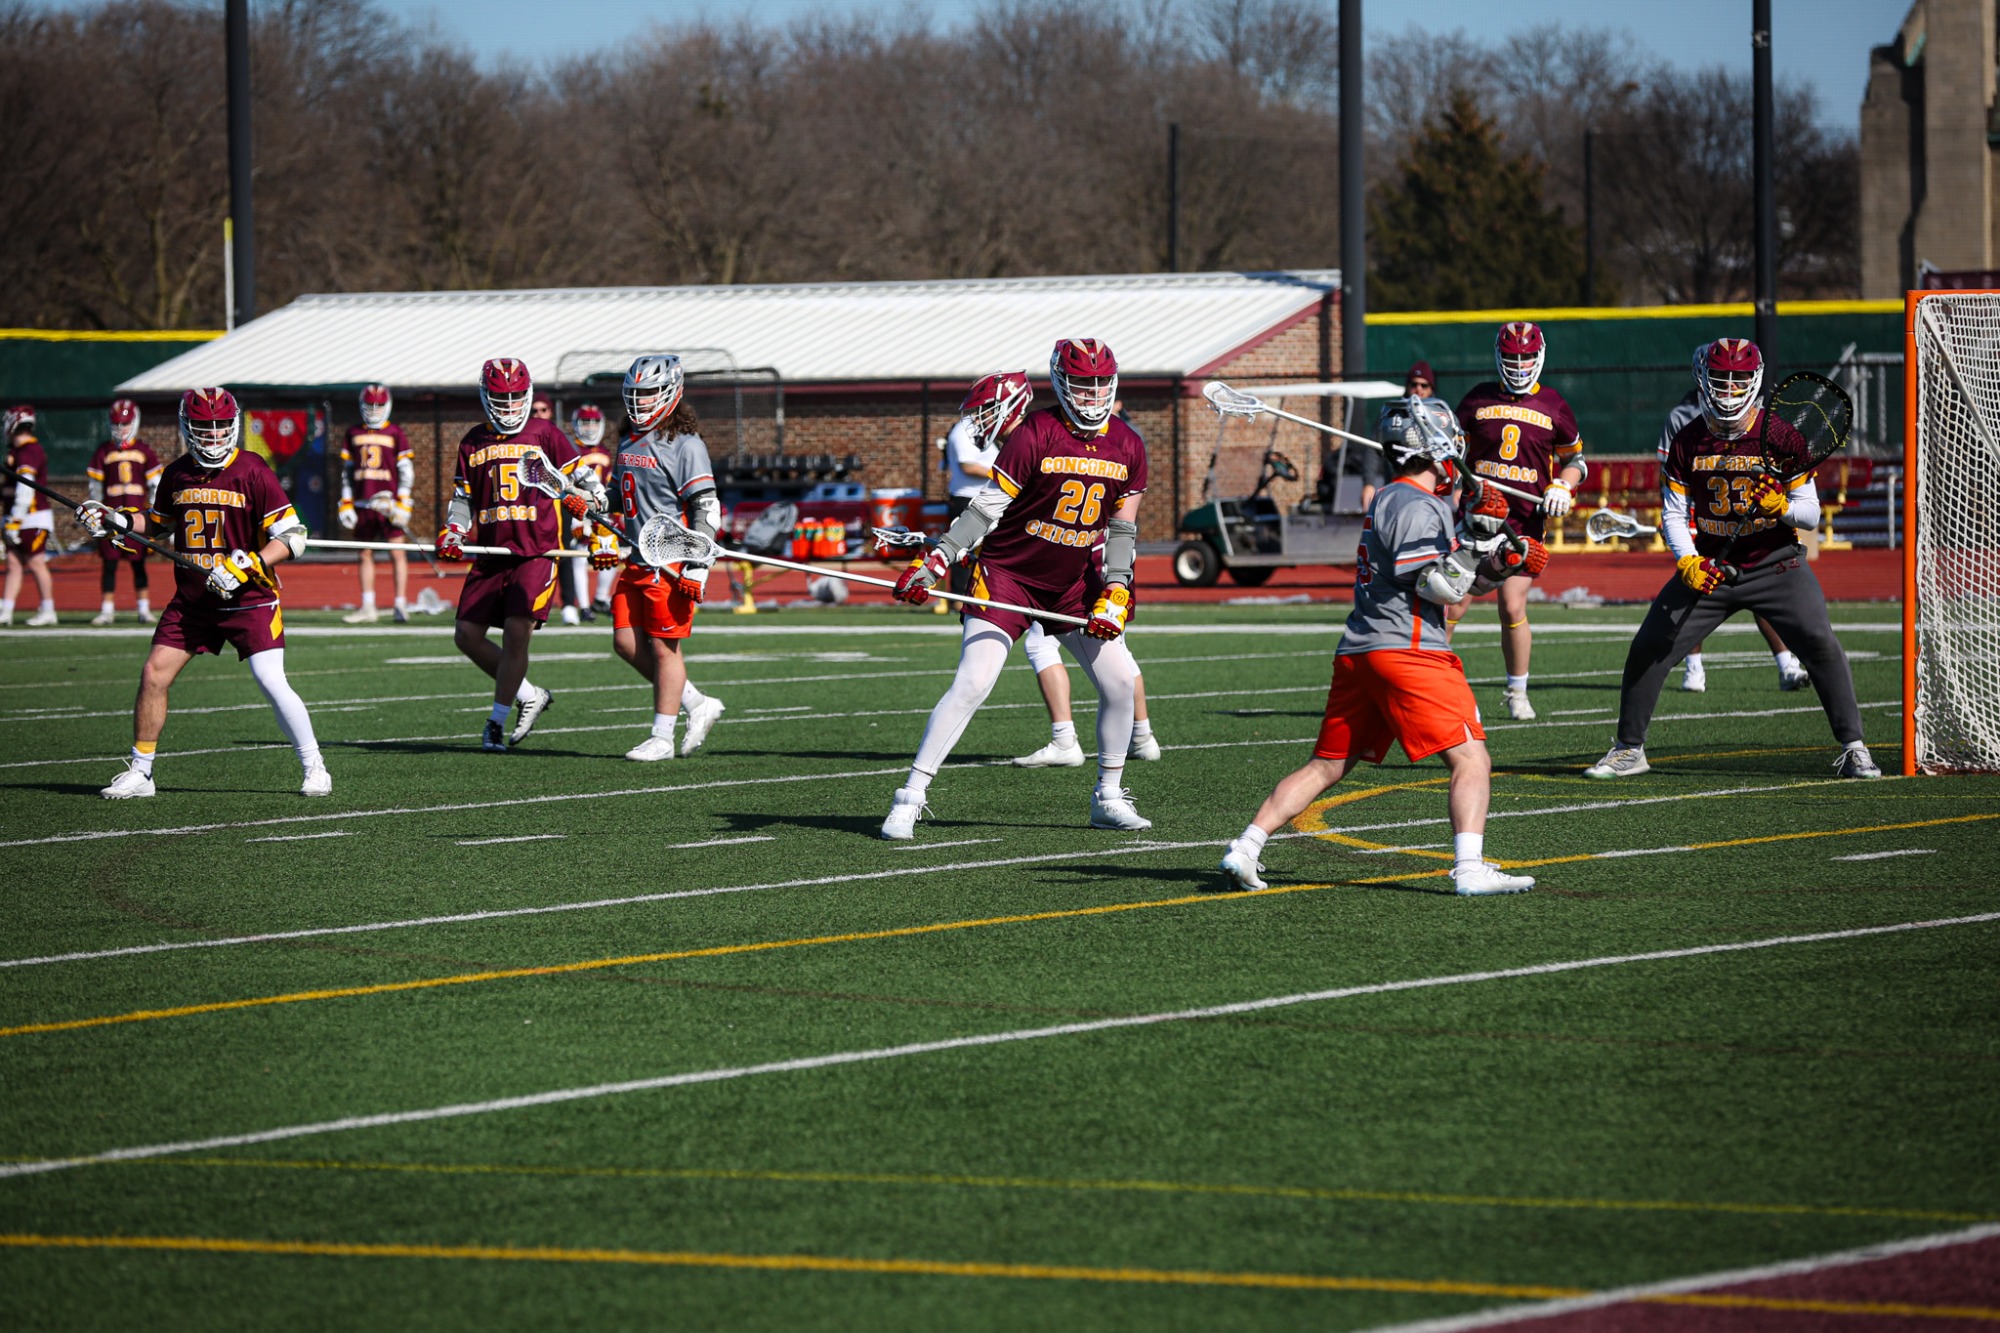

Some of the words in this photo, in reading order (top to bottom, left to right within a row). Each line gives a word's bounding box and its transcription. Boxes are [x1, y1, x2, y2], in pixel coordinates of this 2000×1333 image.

[1475, 404, 1553, 431] CONCORDIA
[1498, 423, 1521, 461] 8
[617, 452, 658, 469] DERSON
[1041, 456, 1129, 481] CONCORDIA
[1474, 459, 1539, 484] CHICAGO
[1692, 454, 1778, 473] ONCORD
[488, 463, 520, 502] 15
[621, 470, 639, 519] 8
[1706, 476, 1755, 516] 33
[172, 487, 246, 509] NCORDIA
[1052, 479, 1106, 526] 26
[479, 504, 537, 525] CCAGO
[184, 509, 226, 549] 27
[1025, 519, 1104, 548] CHICAG
